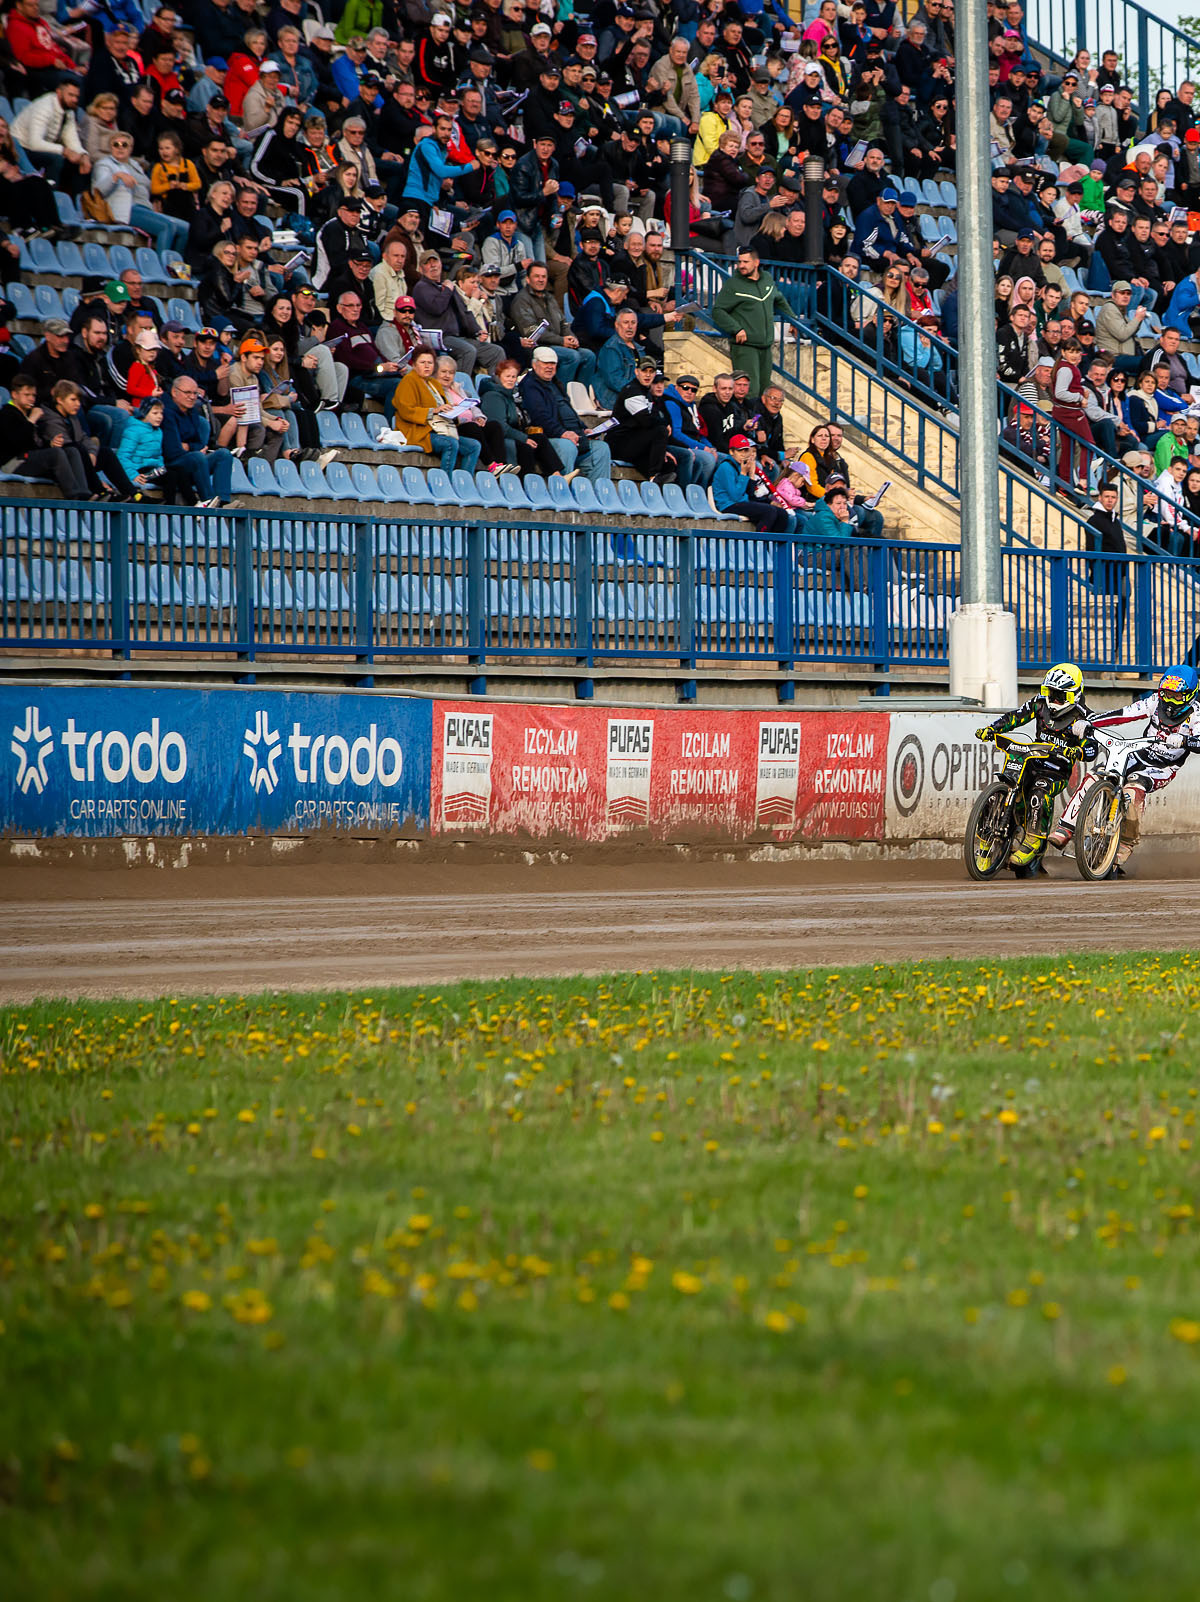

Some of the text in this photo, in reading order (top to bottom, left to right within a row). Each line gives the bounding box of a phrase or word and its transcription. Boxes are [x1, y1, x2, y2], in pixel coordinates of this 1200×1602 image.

[447, 718, 490, 748] PUFAS
[524, 727, 578, 756] IZCILAM
[609, 725, 651, 753] PUFAS
[681, 732, 731, 758] IZCILAM
[761, 727, 799, 755] PUFAS
[827, 733, 874, 759] IZCILAM
[61, 718, 187, 783] trodo
[288, 722, 402, 786] trodo
[511, 765, 588, 793] REMONTAM
[931, 742, 1002, 791] OPTIBE
[670, 769, 738, 795] REMONTAM
[814, 768, 882, 794] REMONTAM
[70, 799, 187, 819] CAR PARTS ONLINE
[294, 799, 317, 819] CAR
[319, 800, 355, 820] PARTS
